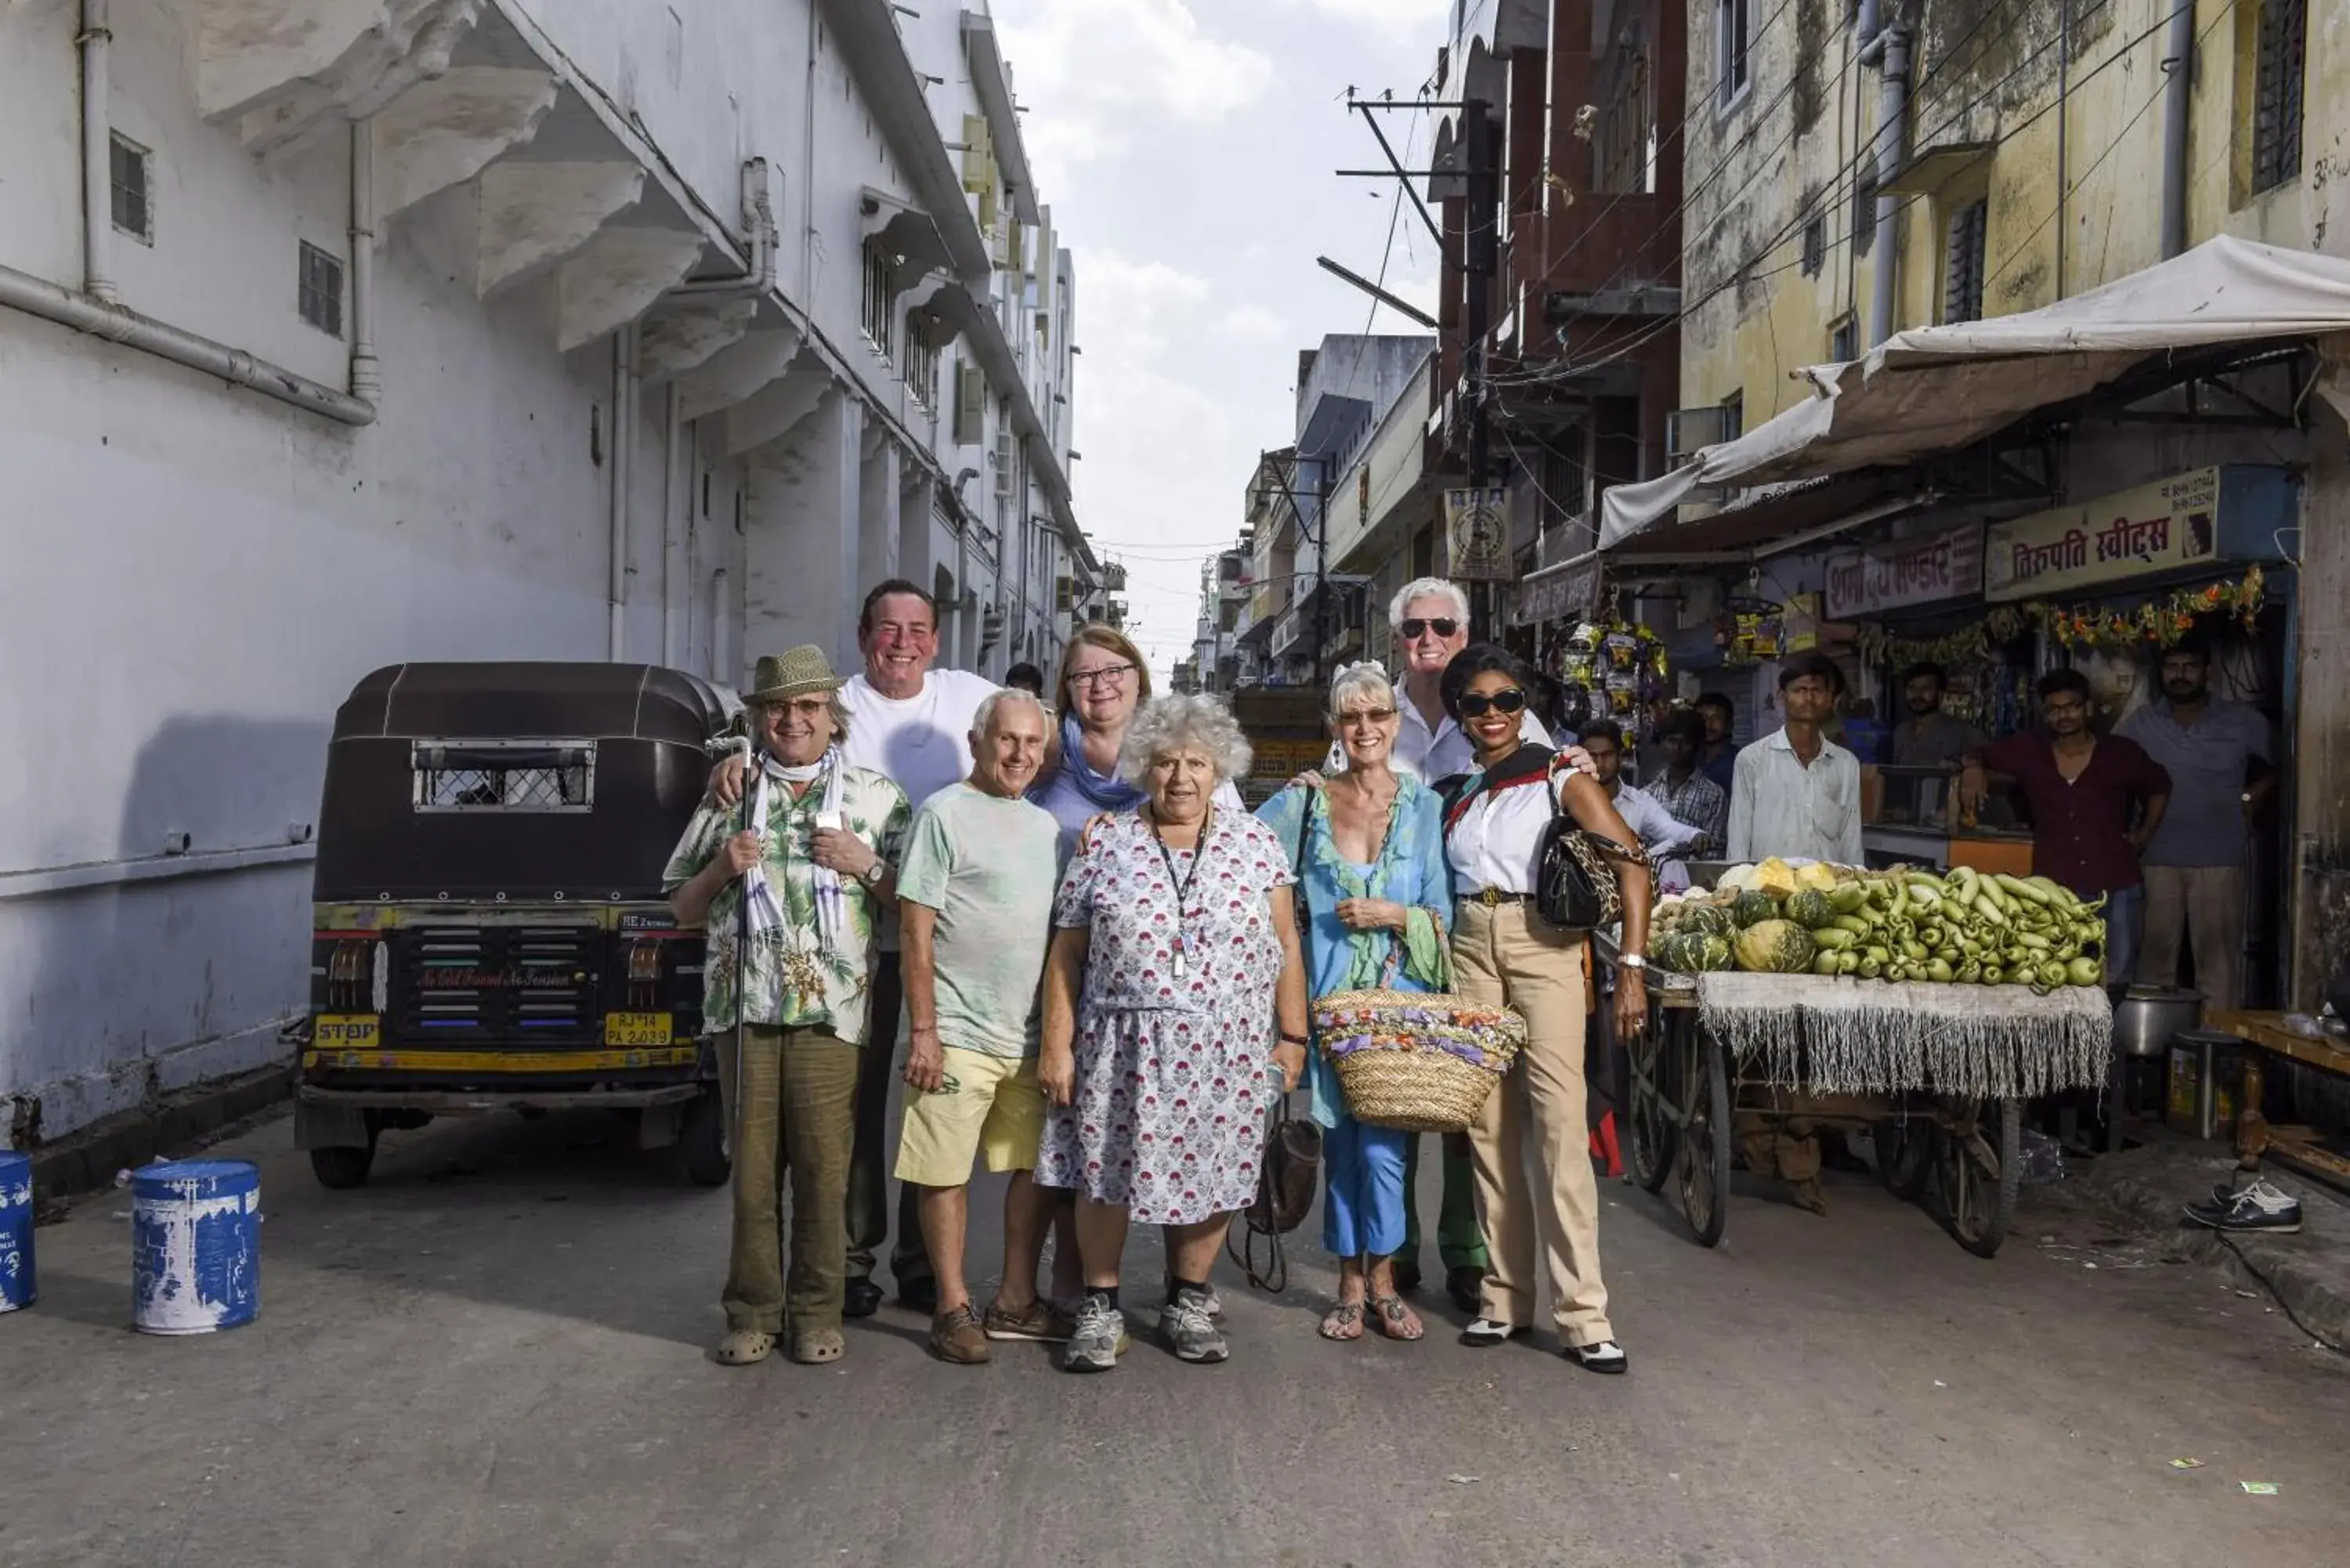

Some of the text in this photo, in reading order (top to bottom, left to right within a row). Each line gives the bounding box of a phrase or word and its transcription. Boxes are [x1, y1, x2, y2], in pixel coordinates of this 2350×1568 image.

[2012, 529, 2089, 580] तिरुपति
[2095, 517, 2171, 562] स्वीट्स
[619, 1014, 656, 1028] RJ 14
[319, 1024, 375, 1040] STOP
[608, 1030, 667, 1045] PA 2039
